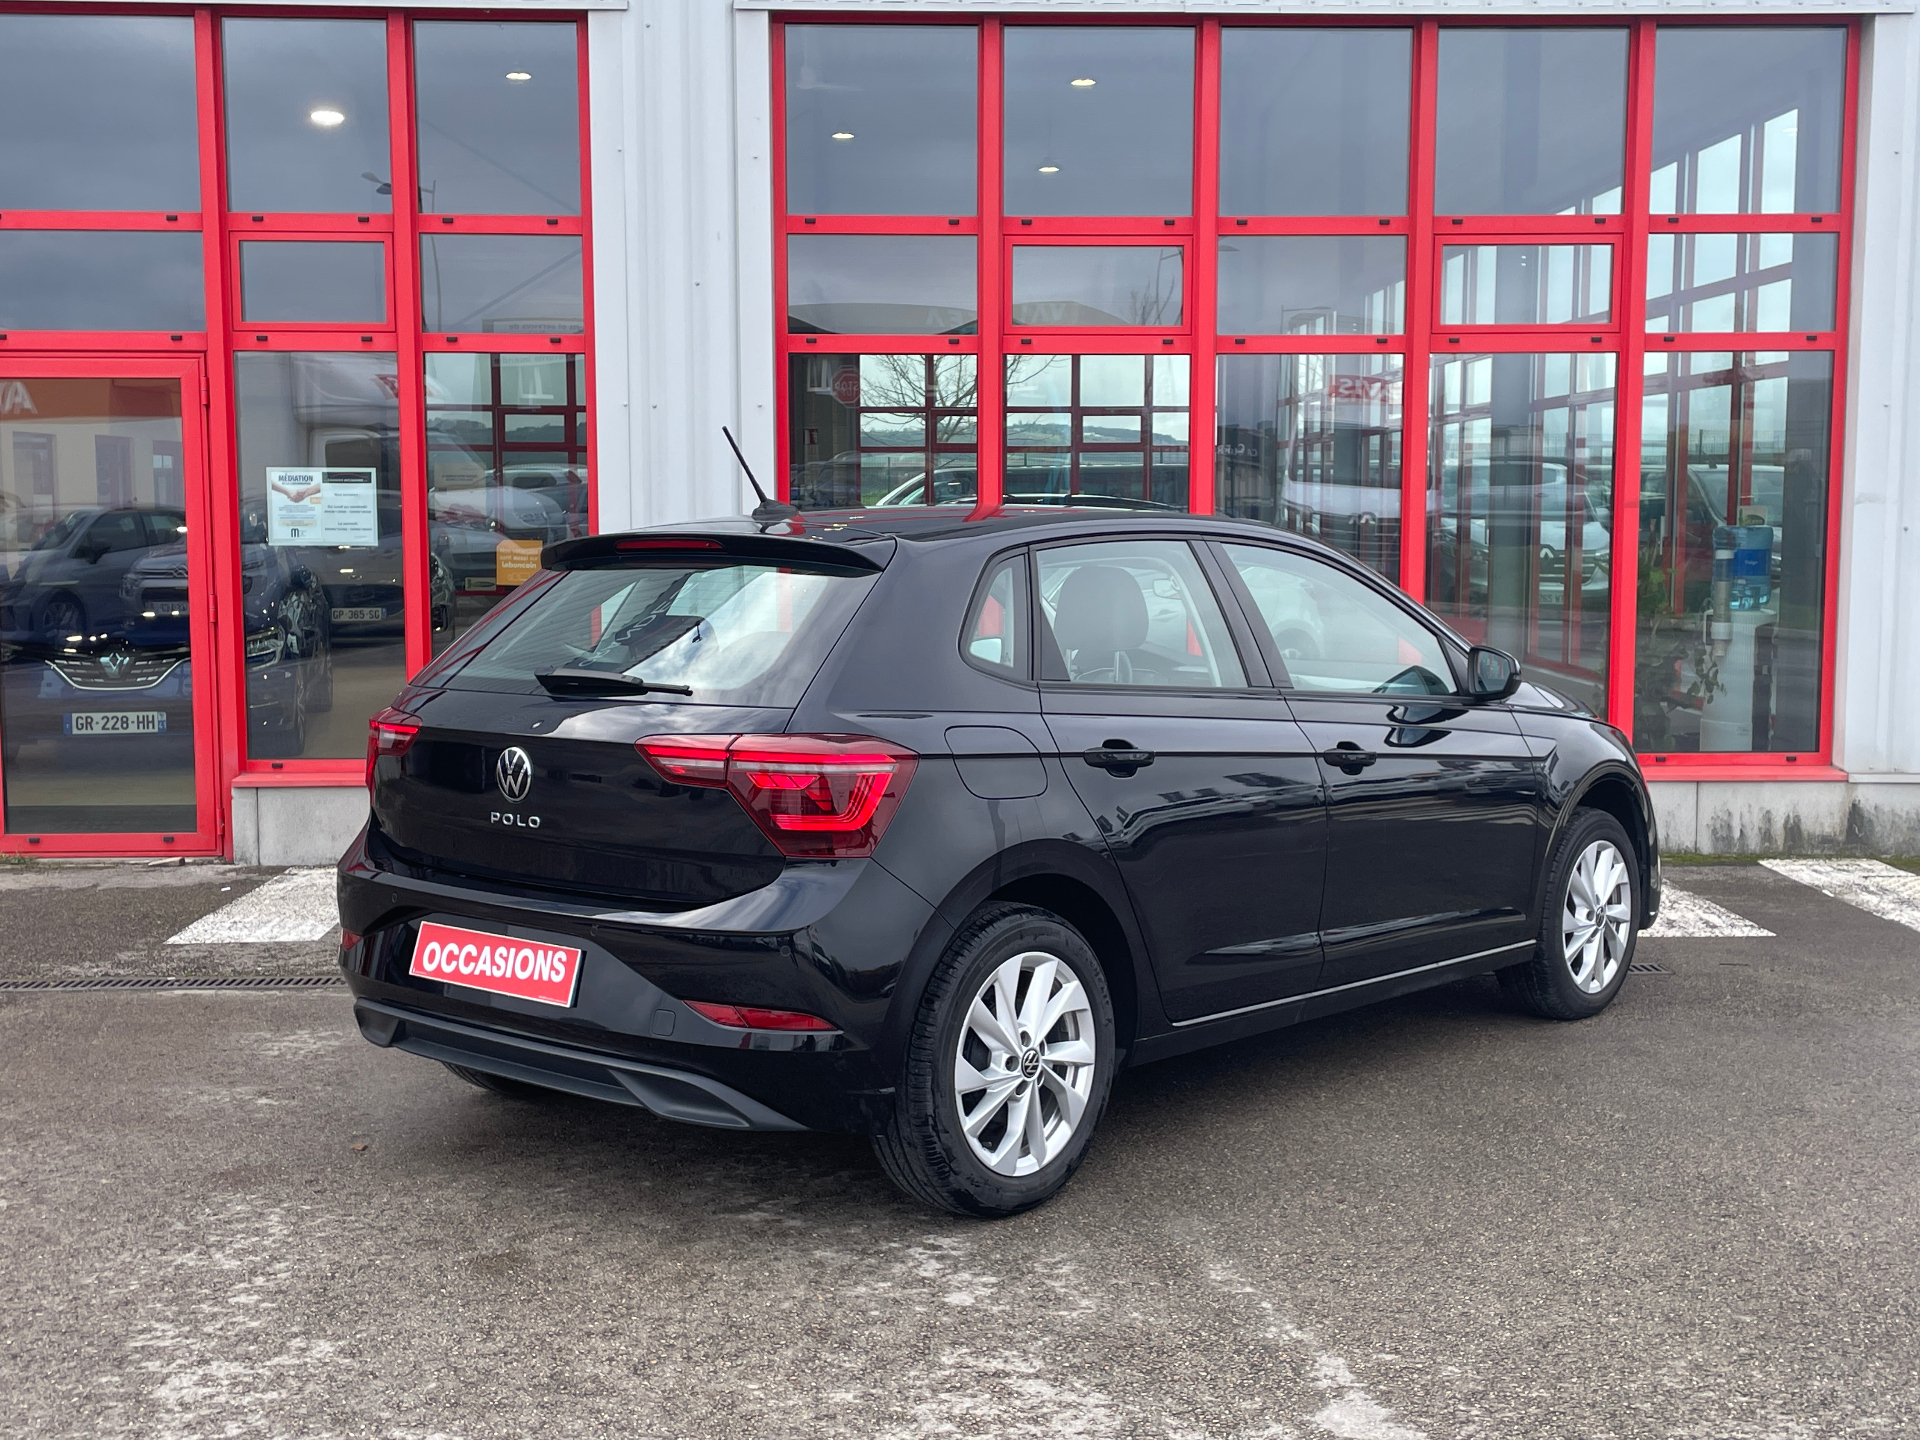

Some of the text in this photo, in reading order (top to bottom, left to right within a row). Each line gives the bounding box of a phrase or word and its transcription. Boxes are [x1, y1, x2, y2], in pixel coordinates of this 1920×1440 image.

[278, 473, 314, 482] MÉDIATION
[75, 714, 155, 731] GR-228-HH
[490, 811, 541, 829] POLO
[422, 941, 568, 983] OCCASIONS
